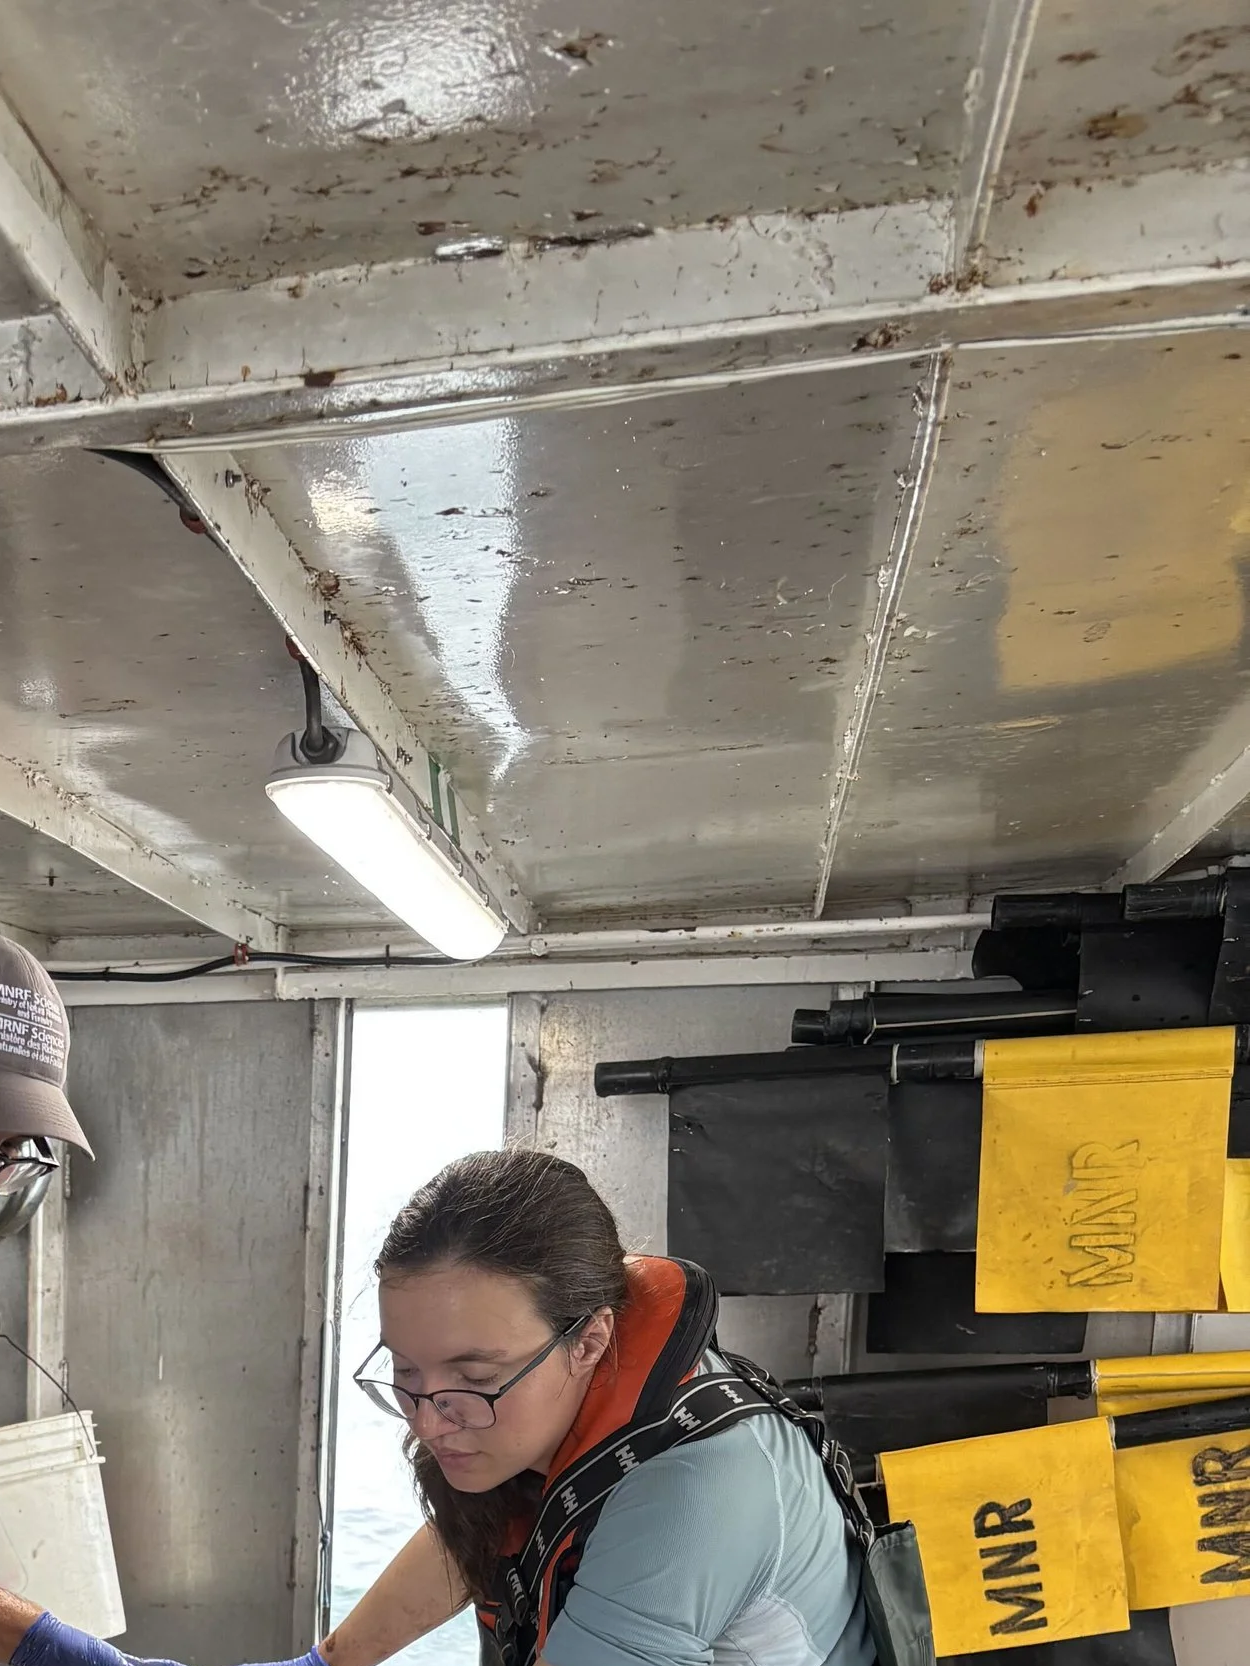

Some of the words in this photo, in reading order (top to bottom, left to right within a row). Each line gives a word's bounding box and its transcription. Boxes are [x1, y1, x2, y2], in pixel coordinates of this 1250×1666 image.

[1065, 1139, 1140, 1287] MNR
[718, 1384, 744, 1404] HH
[674, 1406, 701, 1431] HH
[615, 1444, 640, 1473] HH
[561, 1486, 579, 1515] HH
[1191, 1445, 1250, 1586] MNR
[973, 1497, 1049, 1637] MNR
